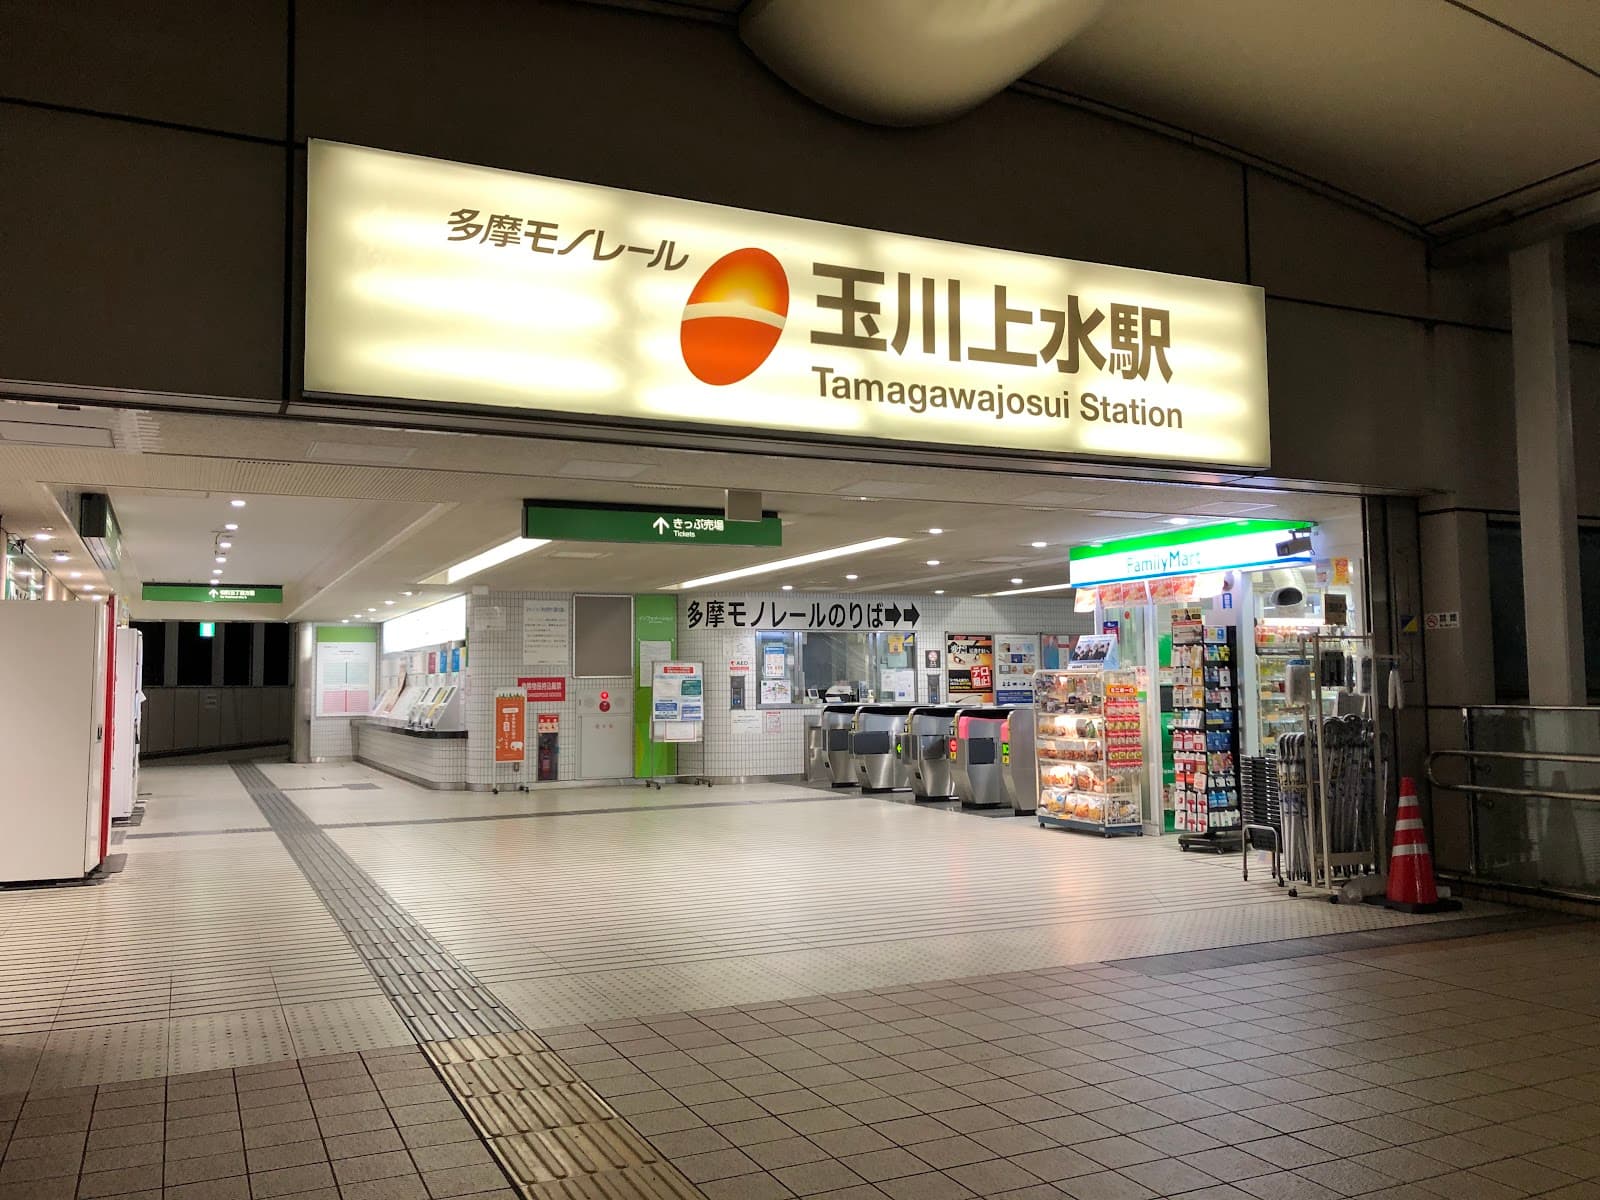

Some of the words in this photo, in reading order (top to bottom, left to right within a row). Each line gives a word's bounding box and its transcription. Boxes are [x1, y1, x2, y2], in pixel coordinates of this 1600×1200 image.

[447, 208, 690, 271] 多摩モノレール
[810, 262, 1174, 384] 玉川上水駅
[811, 366, 1071, 420] Tamagawajosui
[1080, 392, 1183, 429] Station
[672, 518, 724, 531] きっぷ売場
[673, 530, 696, 538] Tickets
[1127, 550, 1200, 574] FamilyMart
[687, 600, 885, 629] 多摩モノレールのりば
[972, 666, 990, 677] テロ
